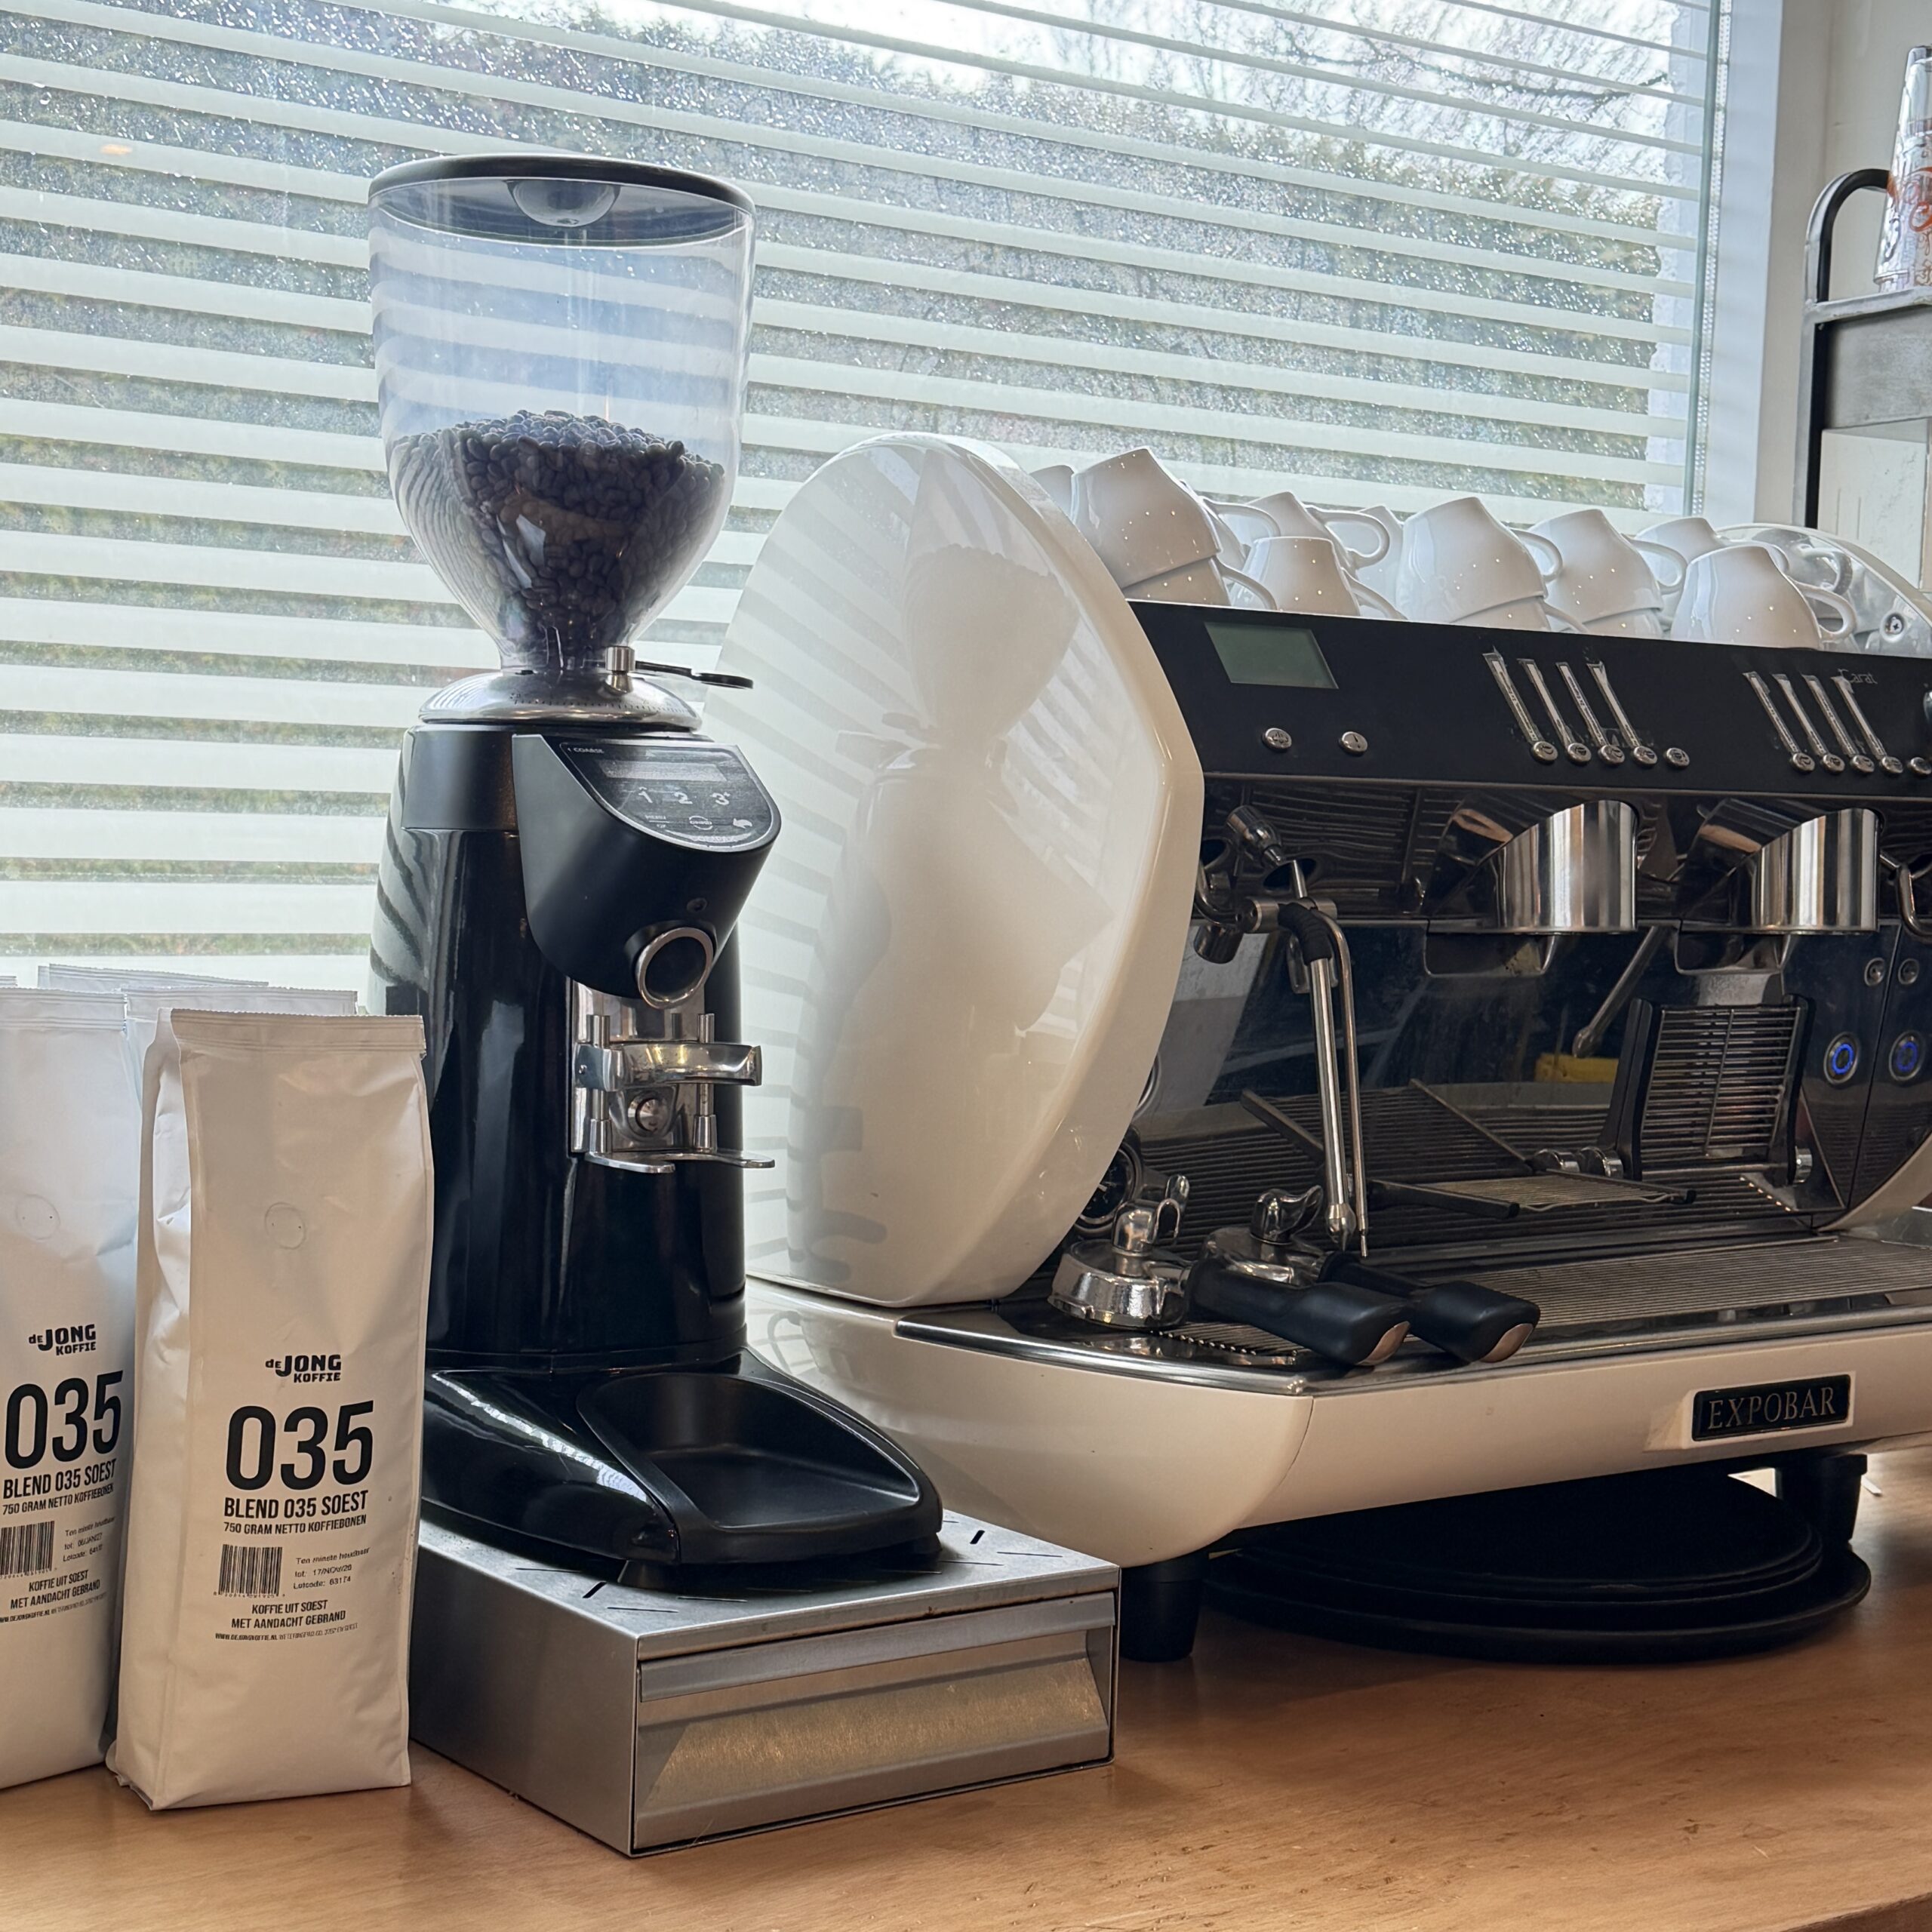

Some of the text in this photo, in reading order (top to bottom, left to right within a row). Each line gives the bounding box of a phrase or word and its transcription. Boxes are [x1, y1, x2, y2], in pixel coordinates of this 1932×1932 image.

[674, 792, 693, 804] 2
[56, 1341, 97, 1356] KOFFIE
[294, 1372, 341, 1383] KOFFIE
[5, 1370, 123, 1469] 035
[1708, 1386, 1836, 1430] EXPOBAR
[226, 1400, 374, 1491] 035
[3, 1458, 116, 1500] BLEND 035 SOEST
[2, 1483, 114, 1515] 750 GRAM NETTO KOFFIEBONEN
[224, 1490, 369, 1518] BLEND 035 SOEST
[223, 1514, 367, 1535] 750 GRAM NETTO KOFFIEBONEN
[29, 1580, 54, 1592] KOFFIE
[57, 1575, 68, 1587] UIT
[69, 1570, 89, 1584] SOEST
[11, 1597, 29, 1610] MET
[30, 1589, 71, 1607] AANDACHT
[72, 1580, 100, 1598] GEBRAND
[251, 1599, 328, 1615] KOFFIE UIT SOEST
[232, 1610, 346, 1629] MET AANDACHT GEBRAND
